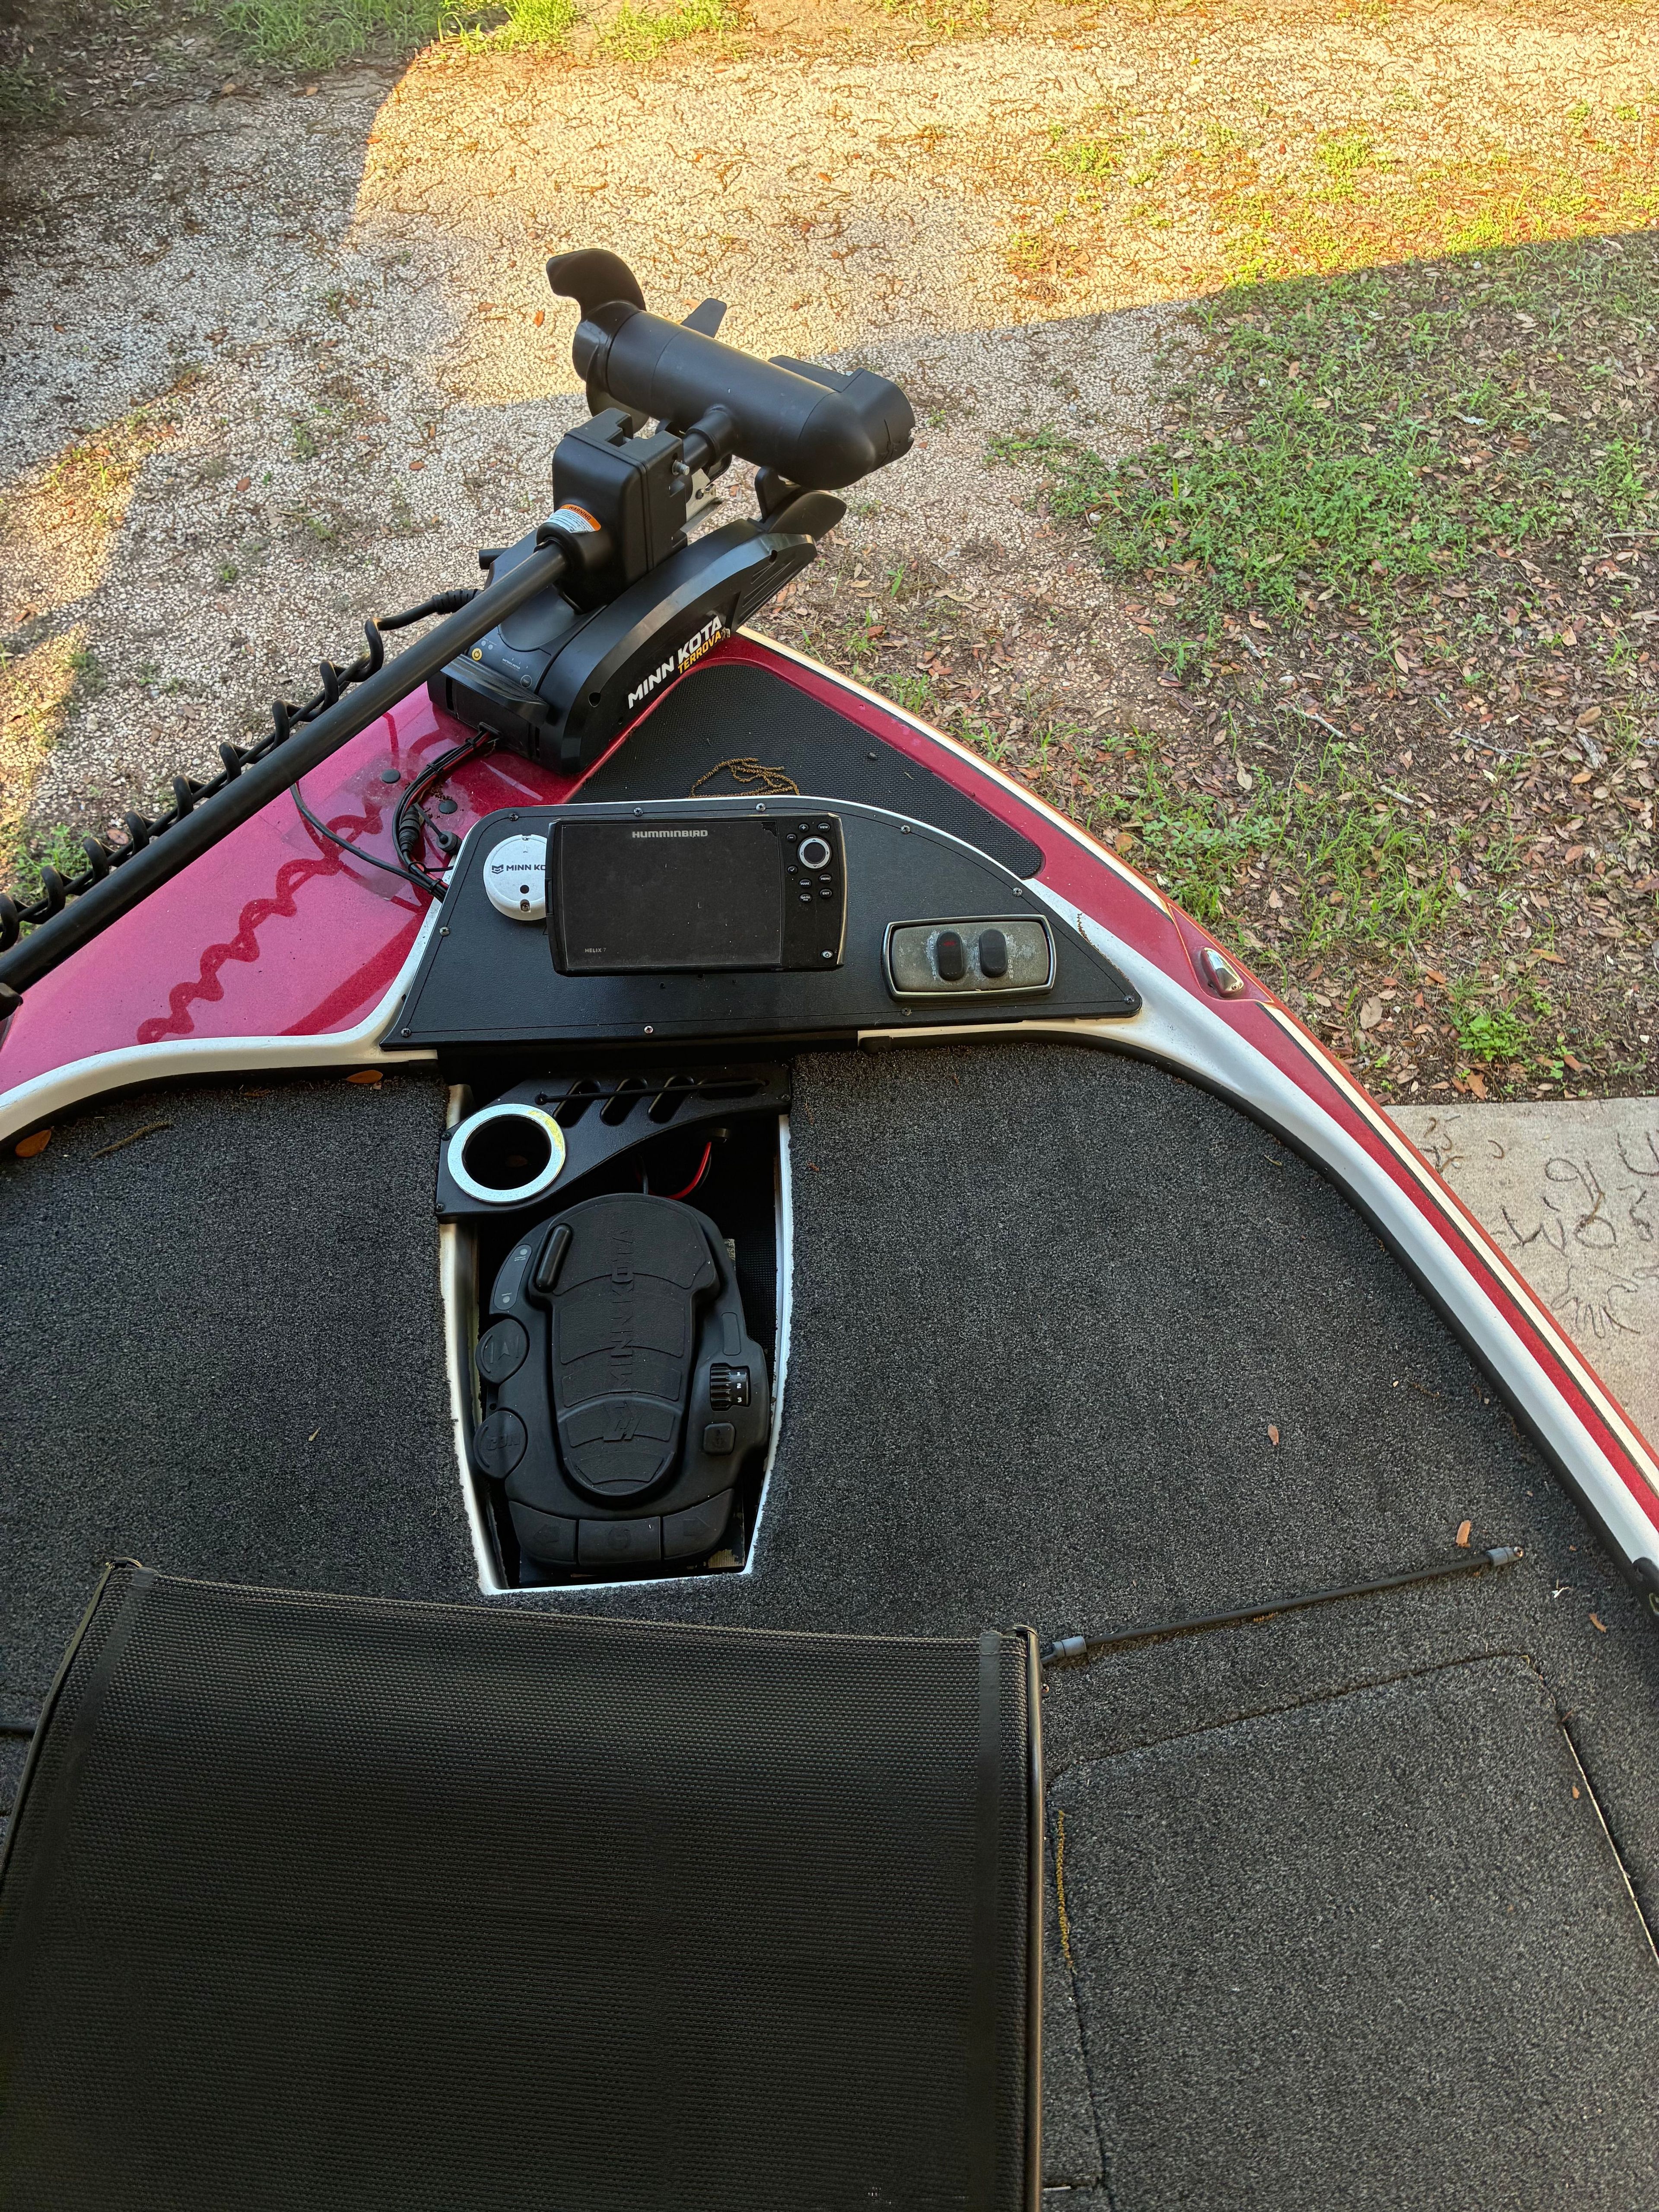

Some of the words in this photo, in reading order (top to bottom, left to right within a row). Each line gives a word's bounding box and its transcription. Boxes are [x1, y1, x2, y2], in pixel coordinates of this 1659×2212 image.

[569, 506, 591, 521] WARNING
[628, 656, 674, 709] MINN
[678, 616, 722, 664] KOTA
[677, 631, 721, 674] TERROVA
[632, 830, 708, 838] HUMMINBIRD
